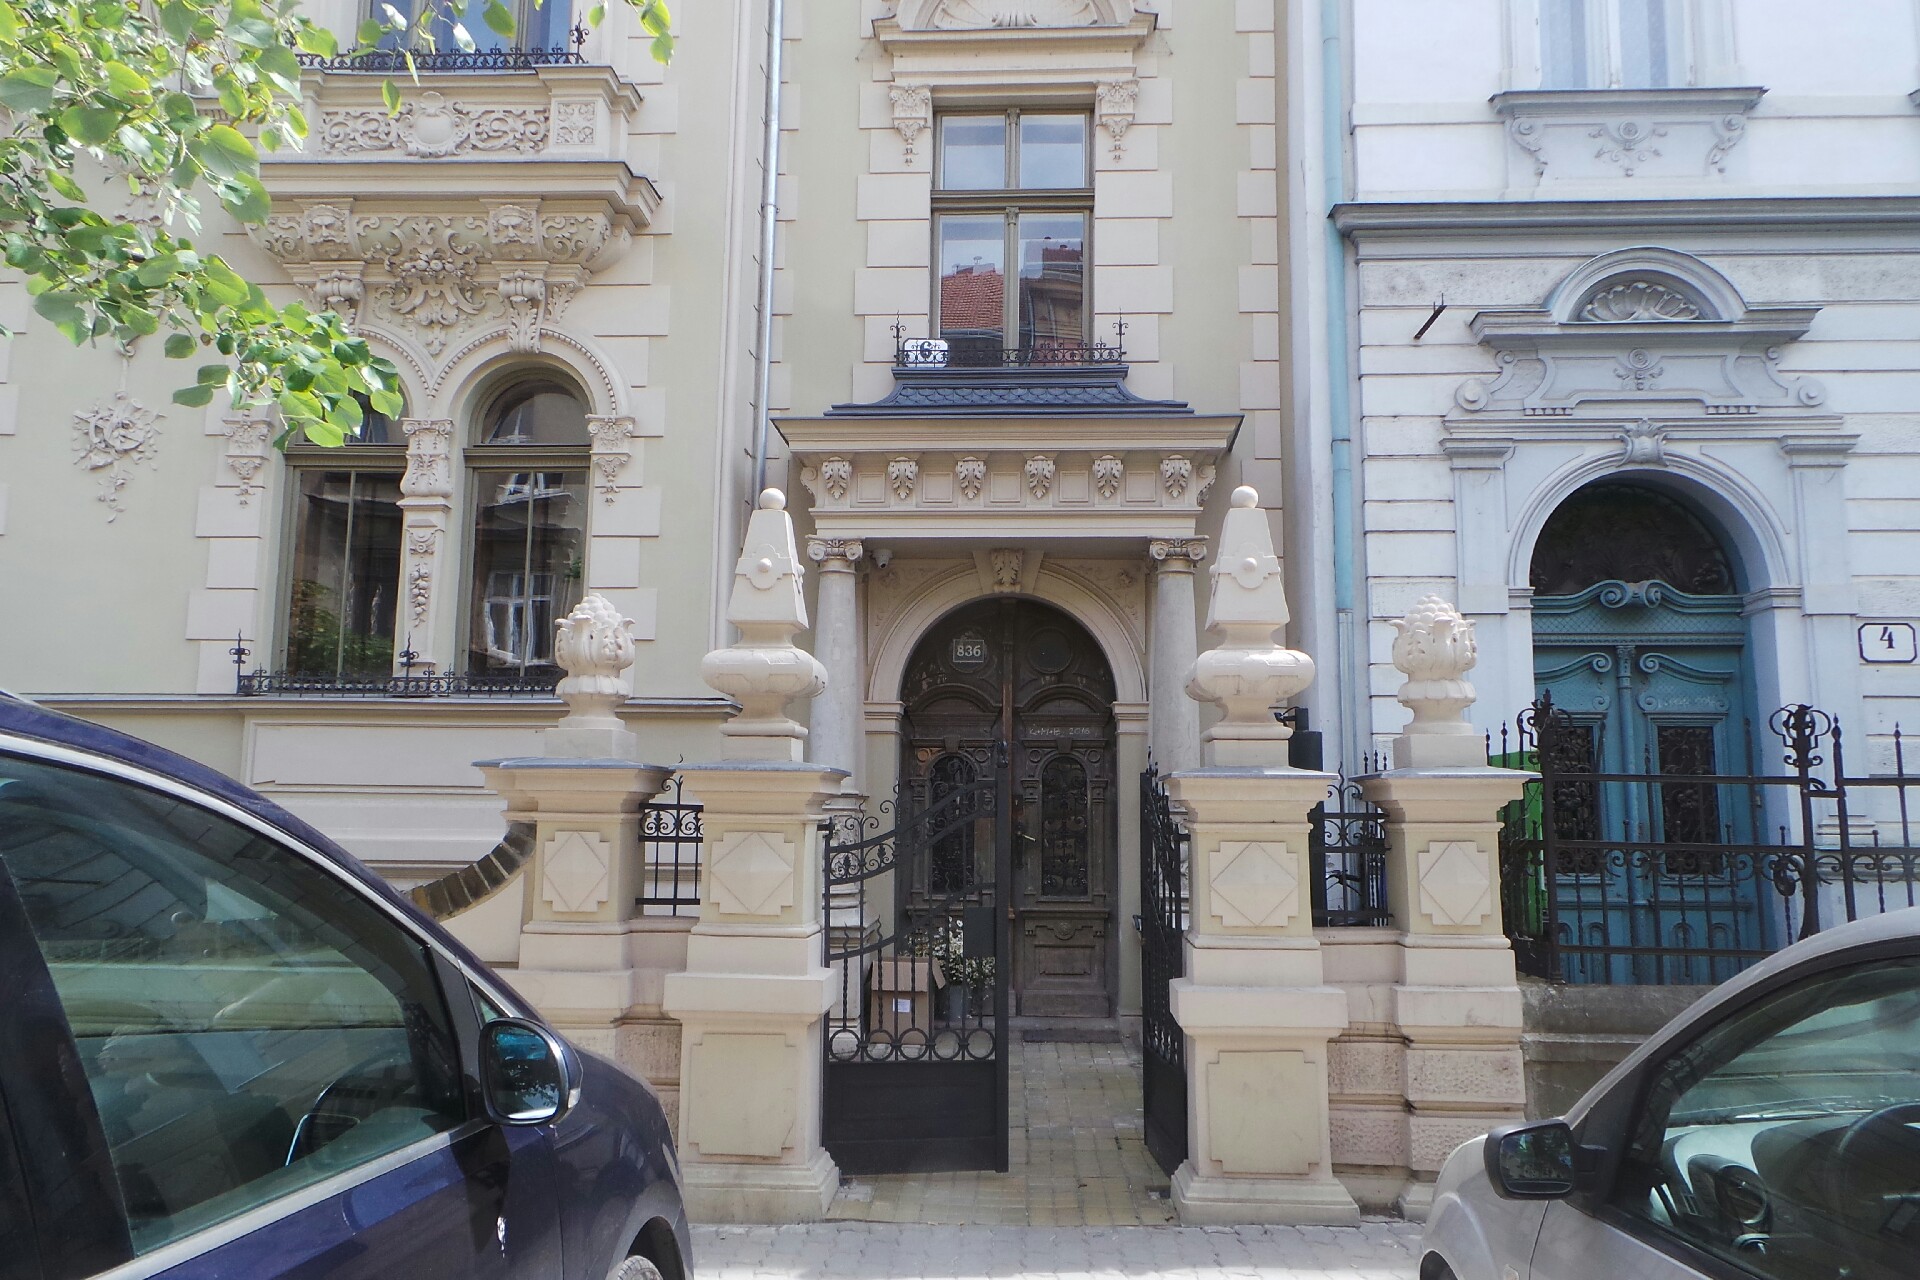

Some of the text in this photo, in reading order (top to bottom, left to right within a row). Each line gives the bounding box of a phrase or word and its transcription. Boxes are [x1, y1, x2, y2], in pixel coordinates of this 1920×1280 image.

[920, 340, 932, 358] 6
[1880, 626, 1895, 649] 4
[956, 645, 981, 657] 836
